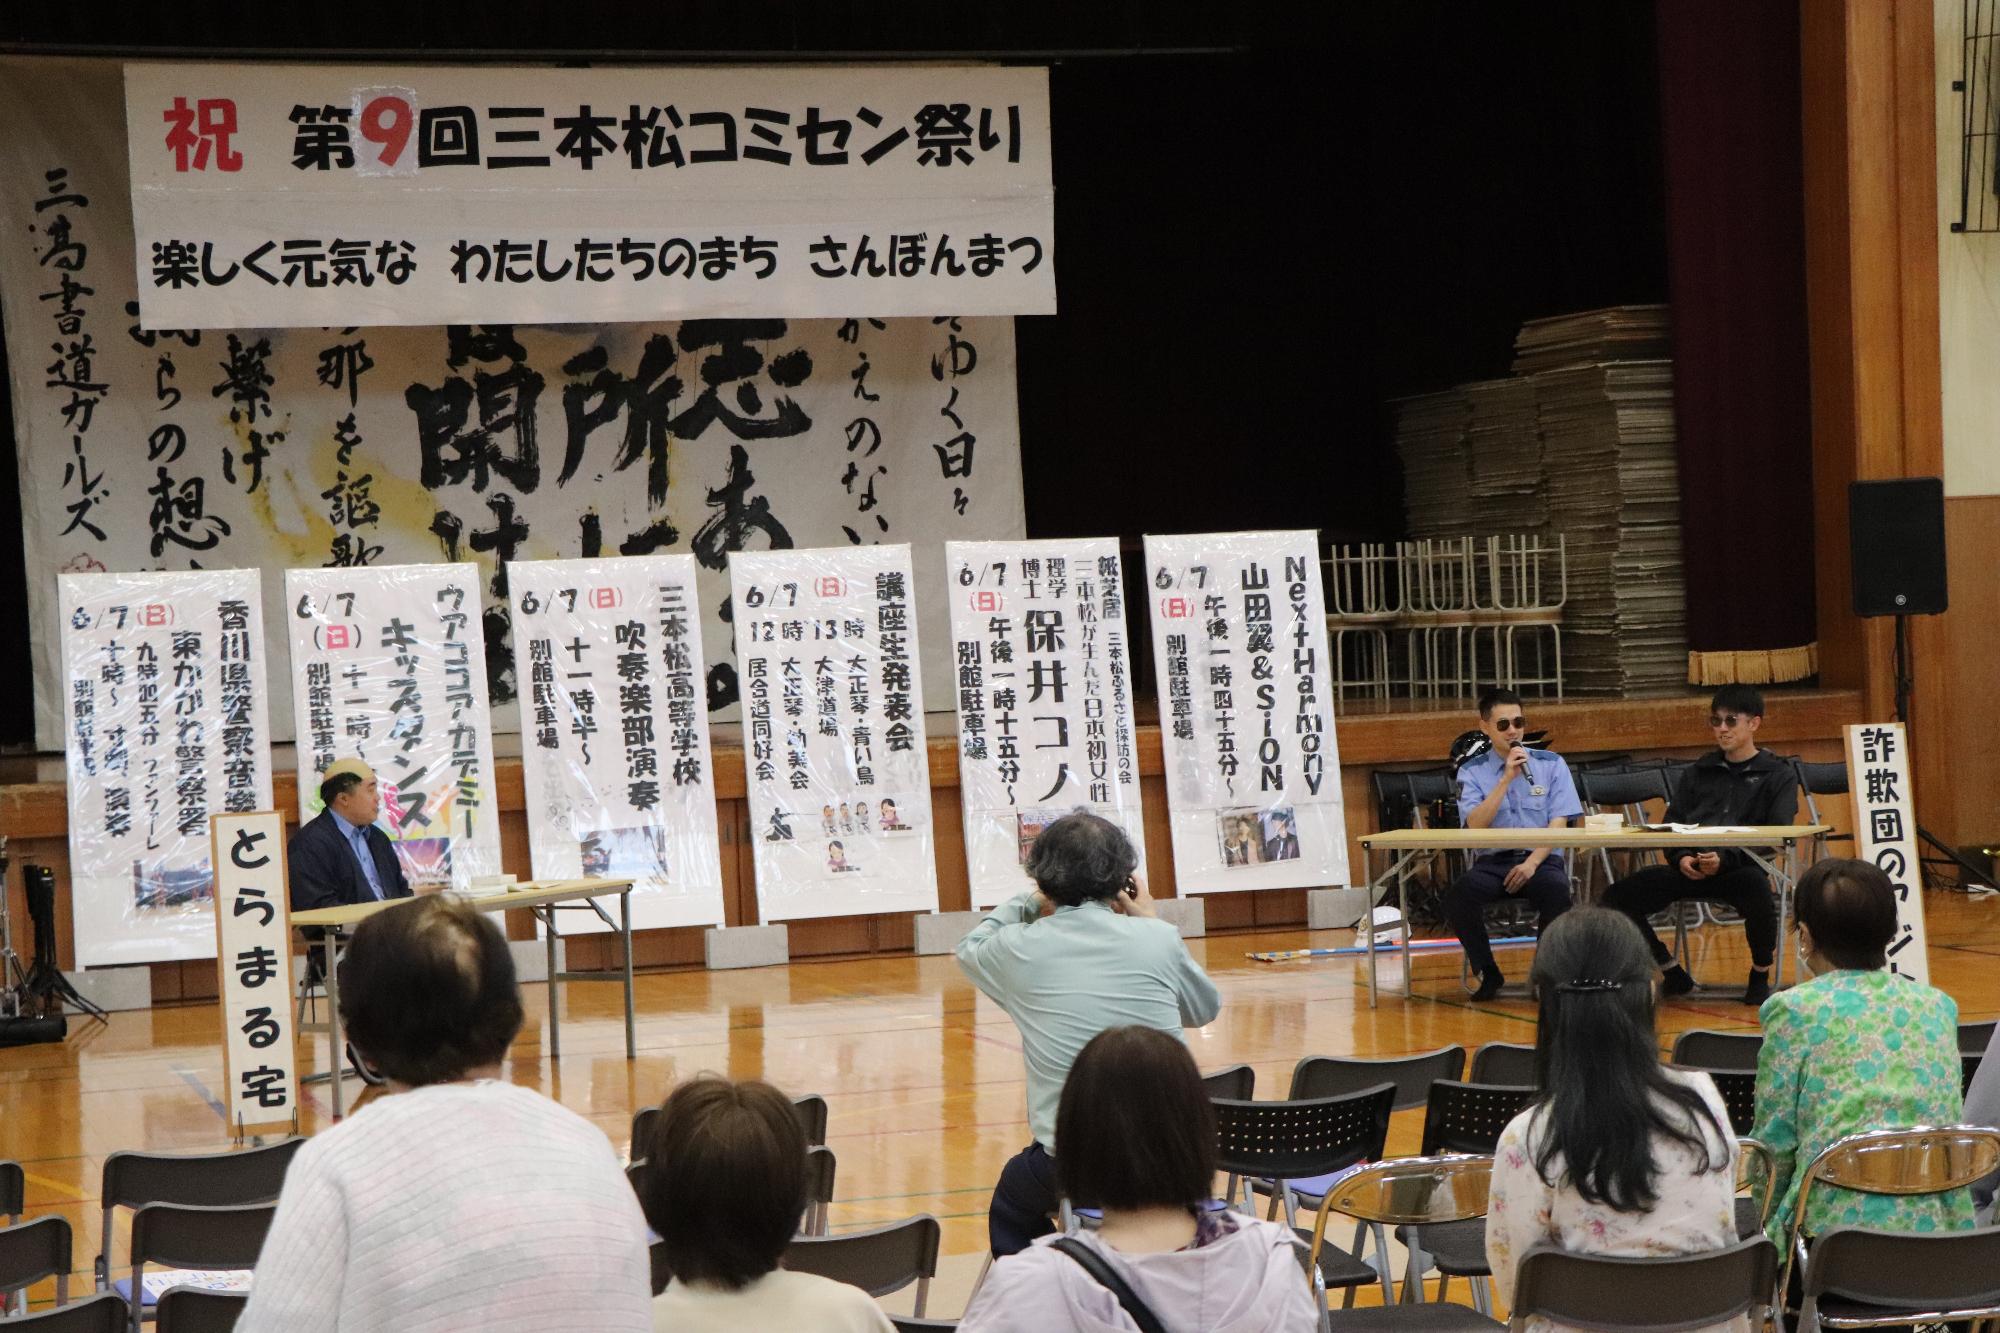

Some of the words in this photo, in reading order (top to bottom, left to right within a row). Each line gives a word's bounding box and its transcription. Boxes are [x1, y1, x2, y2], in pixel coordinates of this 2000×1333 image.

[163, 97, 243, 172] 祝
[288, 96, 1020, 171] 第9回三本松コミセン祭り
[152, 238, 416, 289] 楽しく元気な
[450, 236, 779, 283] わたしたちのまち
[809, 232, 1043, 278] さんぼんまつ
[35, 168, 110, 541] 三高書道ガールズ
[529, 638, 560, 750] 別館駐車場
[615, 620, 661, 812] 吹奏楽部演奏
[658, 586, 702, 787] 三本松高等学校
[748, 658, 776, 781] 居合道同好会
[875, 571, 915, 752] 講座生発表会
[957, 641, 989, 761] 別館駐車場
[1023, 609, 1069, 802] 保井コノ
[1074, 559, 1112, 803] 三本松が生んだ日本初女性
[230, 828, 287, 1108] とらまる宅
